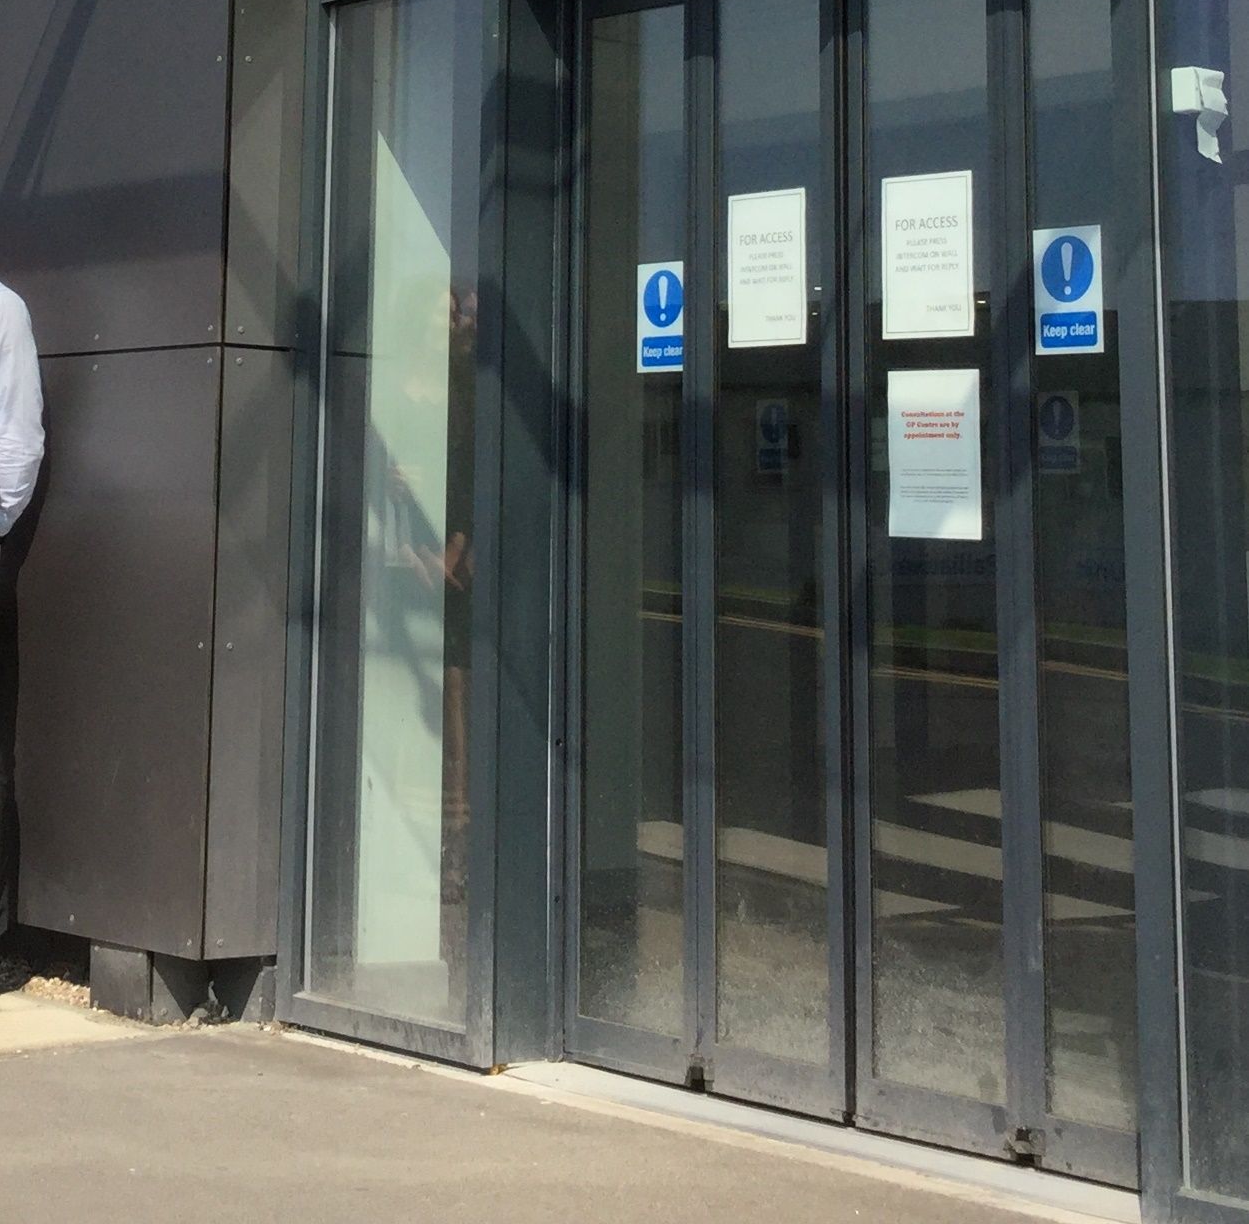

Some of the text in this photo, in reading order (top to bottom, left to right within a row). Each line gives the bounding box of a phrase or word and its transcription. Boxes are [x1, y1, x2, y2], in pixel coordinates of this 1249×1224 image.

[895, 215, 958, 231] FOR ACCESS
[739, 231, 793, 246] FOR ACCESS
[1043, 323, 1095, 339] Keep clear
[643, 345, 683, 359] Keep clear
